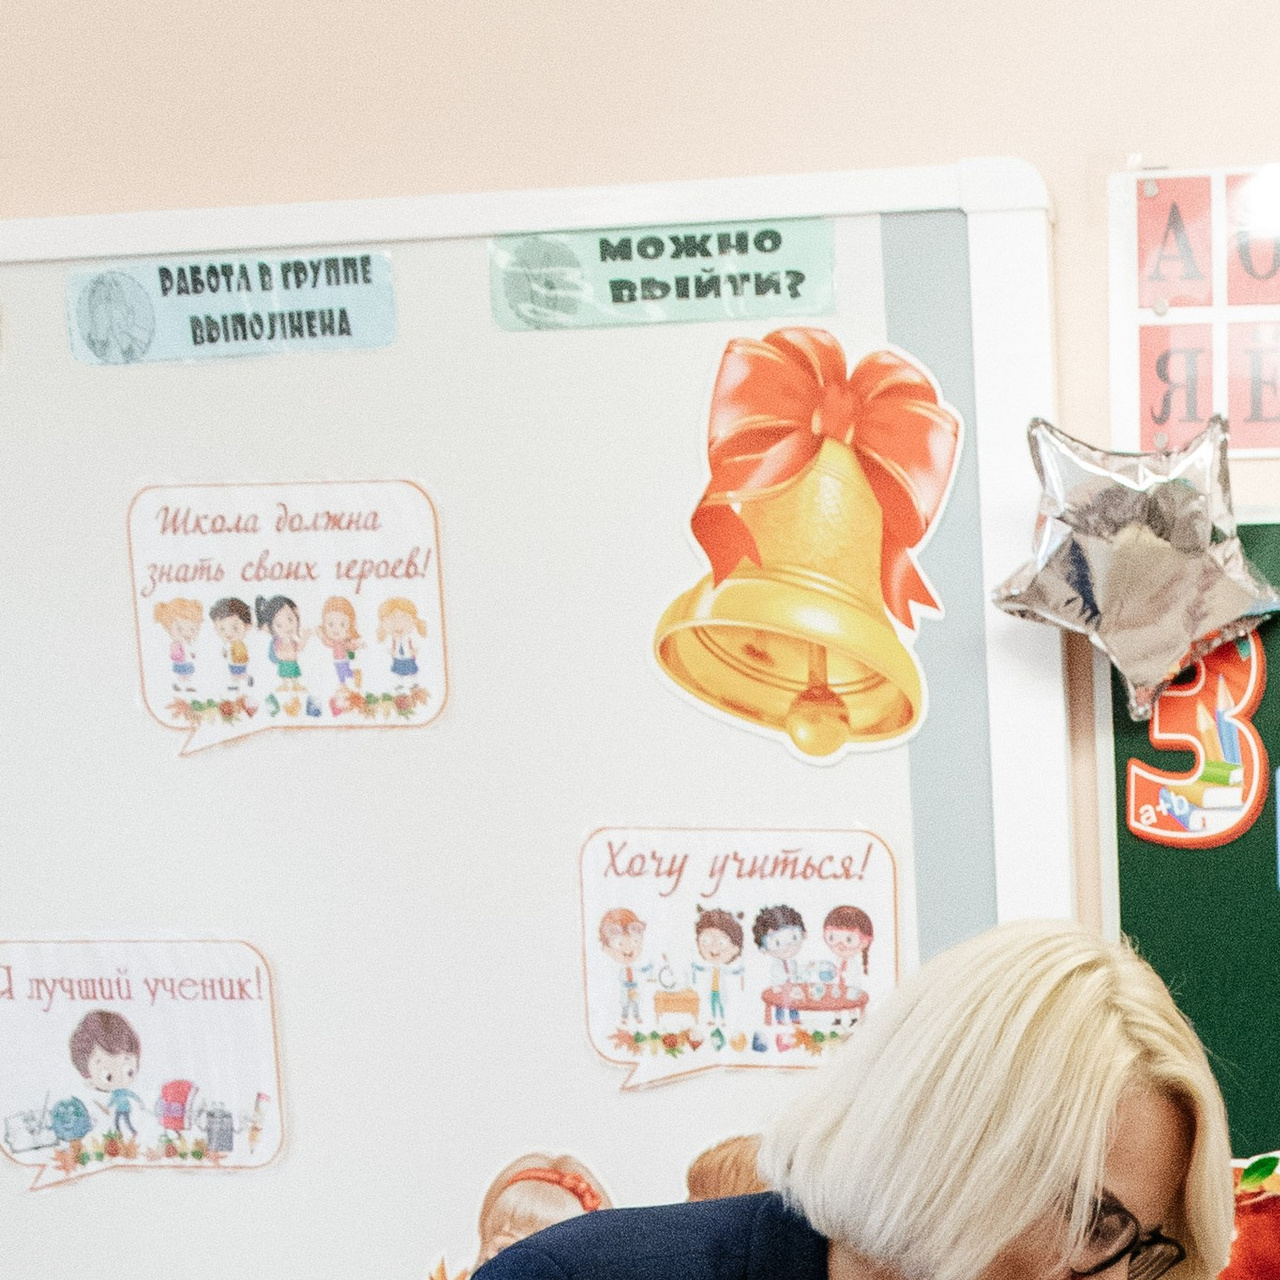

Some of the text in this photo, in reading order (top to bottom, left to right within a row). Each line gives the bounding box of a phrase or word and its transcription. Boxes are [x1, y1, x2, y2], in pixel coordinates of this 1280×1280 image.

[598, 228, 783, 263] МОЖНО
[157, 254, 373, 297] РАБОТА В ГРУППЕ
[608, 267, 806, 304] ВЫЙТИ?
[188, 306, 352, 347] ВЫПОЛНЕНА
[1151, 346, 1207, 425] Я
[157, 501, 384, 536] Школа должна
[140, 546, 432, 598] знать своих героев!
[1137, 792, 1190, 827] a+b
[603, 840, 874, 899] Хочу учиться!
[27, 966, 133, 1013] лучший
[142, 965, 264, 1007] ученик!
